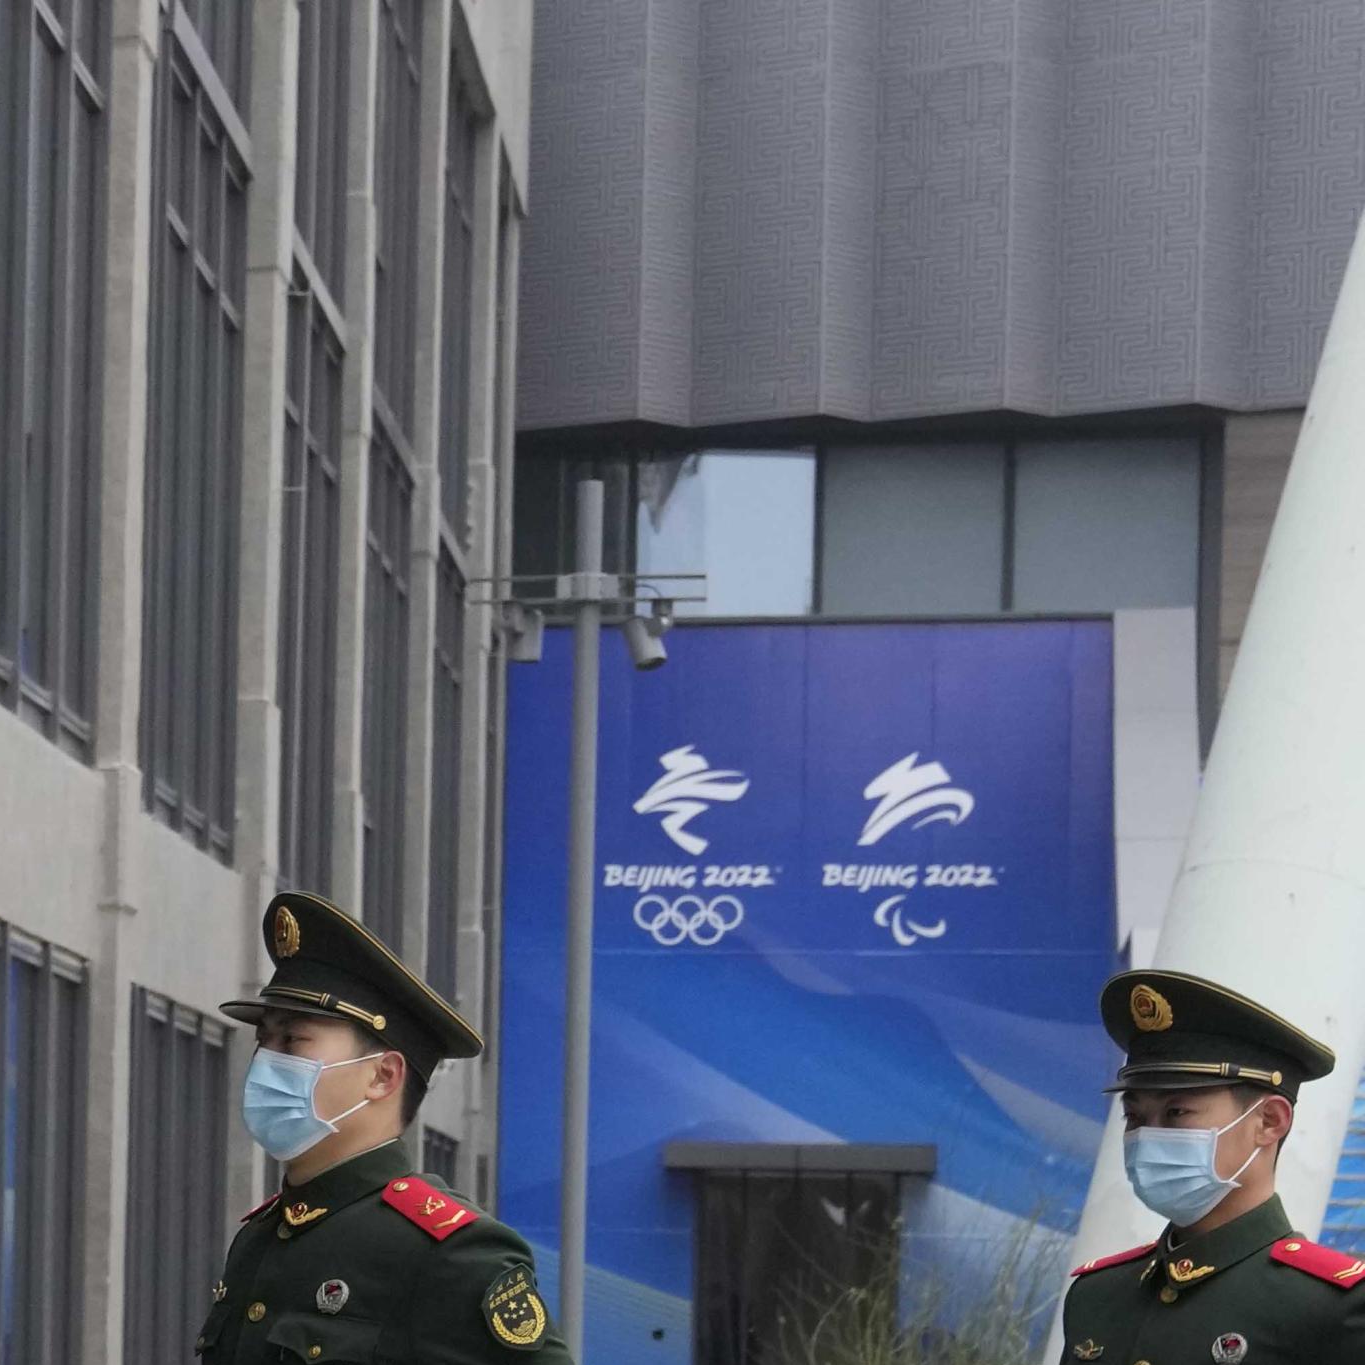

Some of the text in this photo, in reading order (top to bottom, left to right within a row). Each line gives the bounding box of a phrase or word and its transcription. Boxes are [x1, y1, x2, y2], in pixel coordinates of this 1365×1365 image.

[603, 864, 776, 893] BEIJING 2022
[822, 864, 998, 893] BEIJING 2022
